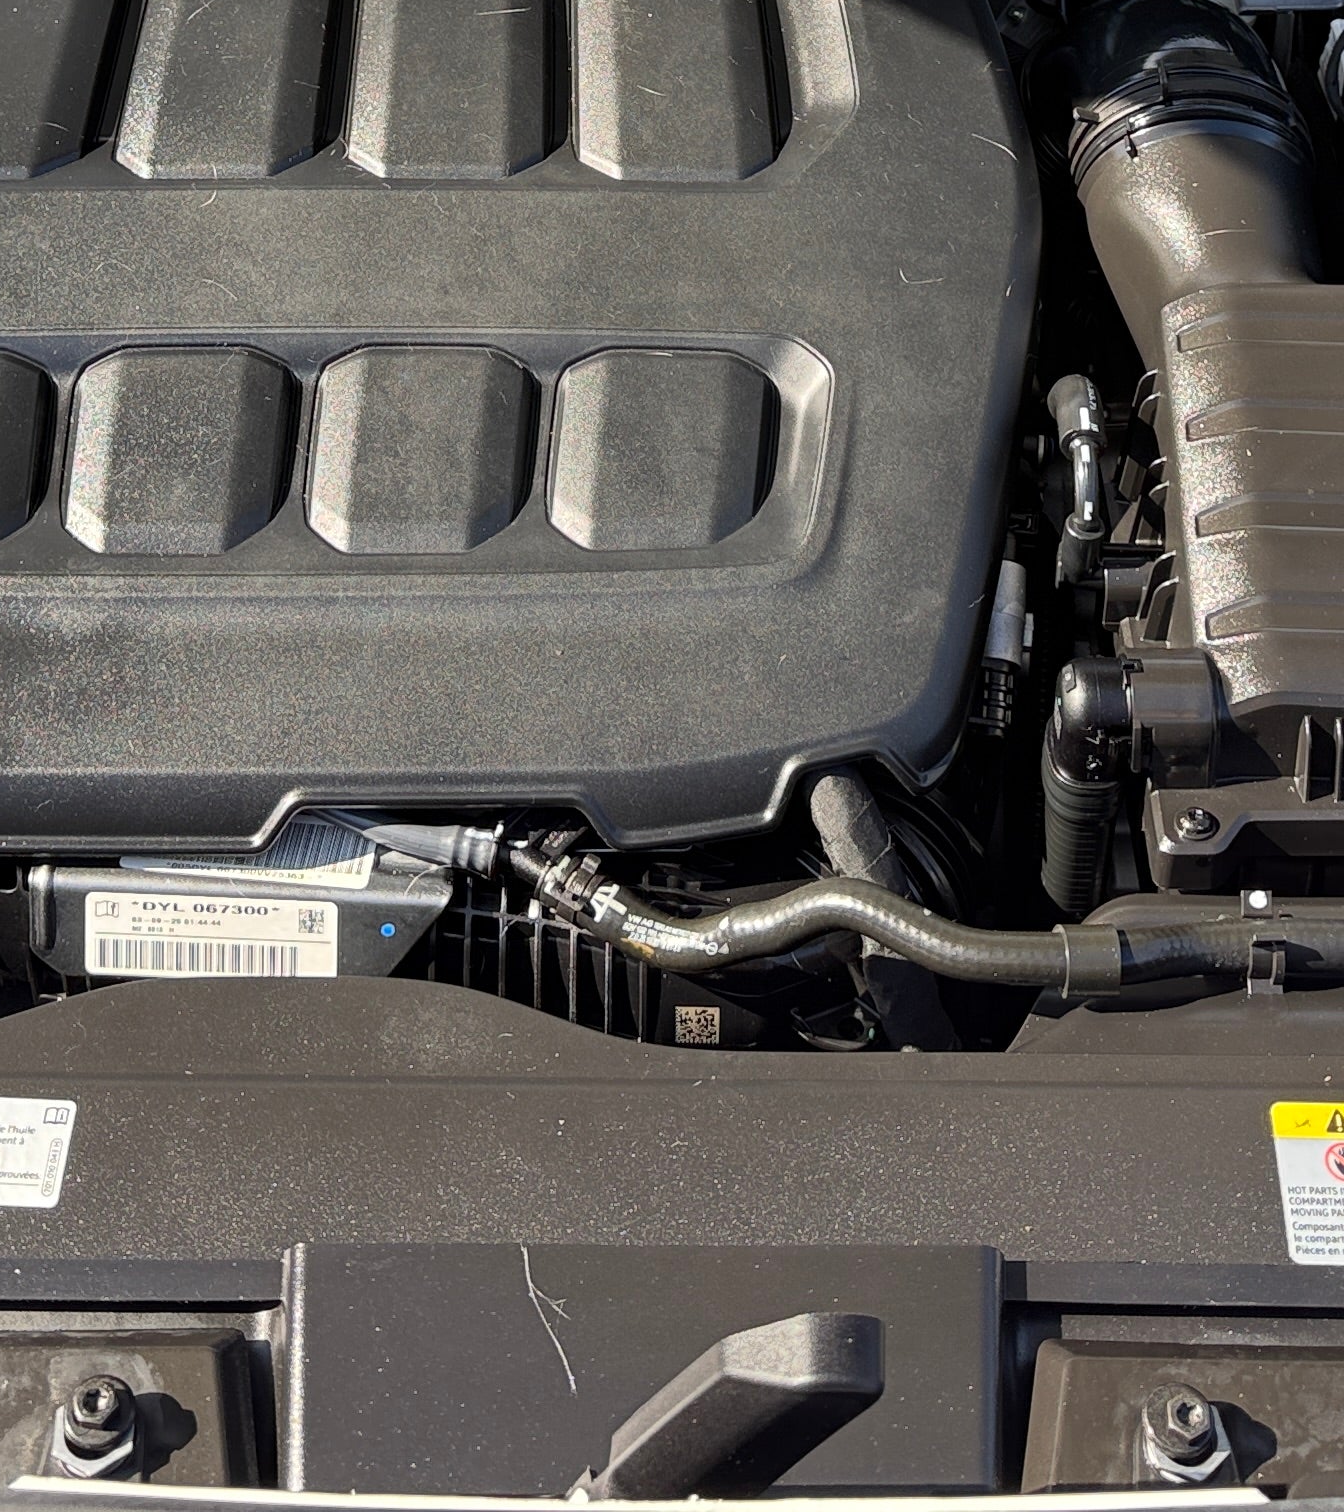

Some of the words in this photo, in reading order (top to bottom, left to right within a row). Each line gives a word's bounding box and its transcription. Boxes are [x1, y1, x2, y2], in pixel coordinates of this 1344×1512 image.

[8, 1125, 36, 1135] l'huile
[1288, 1186, 1306, 1194] HOT
[1310, 1187, 1338, 1195] PARTS
[1291, 1208, 1329, 1216] MOVING
[1294, 1234, 1302, 1242] le
[1296, 1245, 1325, 1255] Pièces
[1328, 1247, 1339, 1255] en
